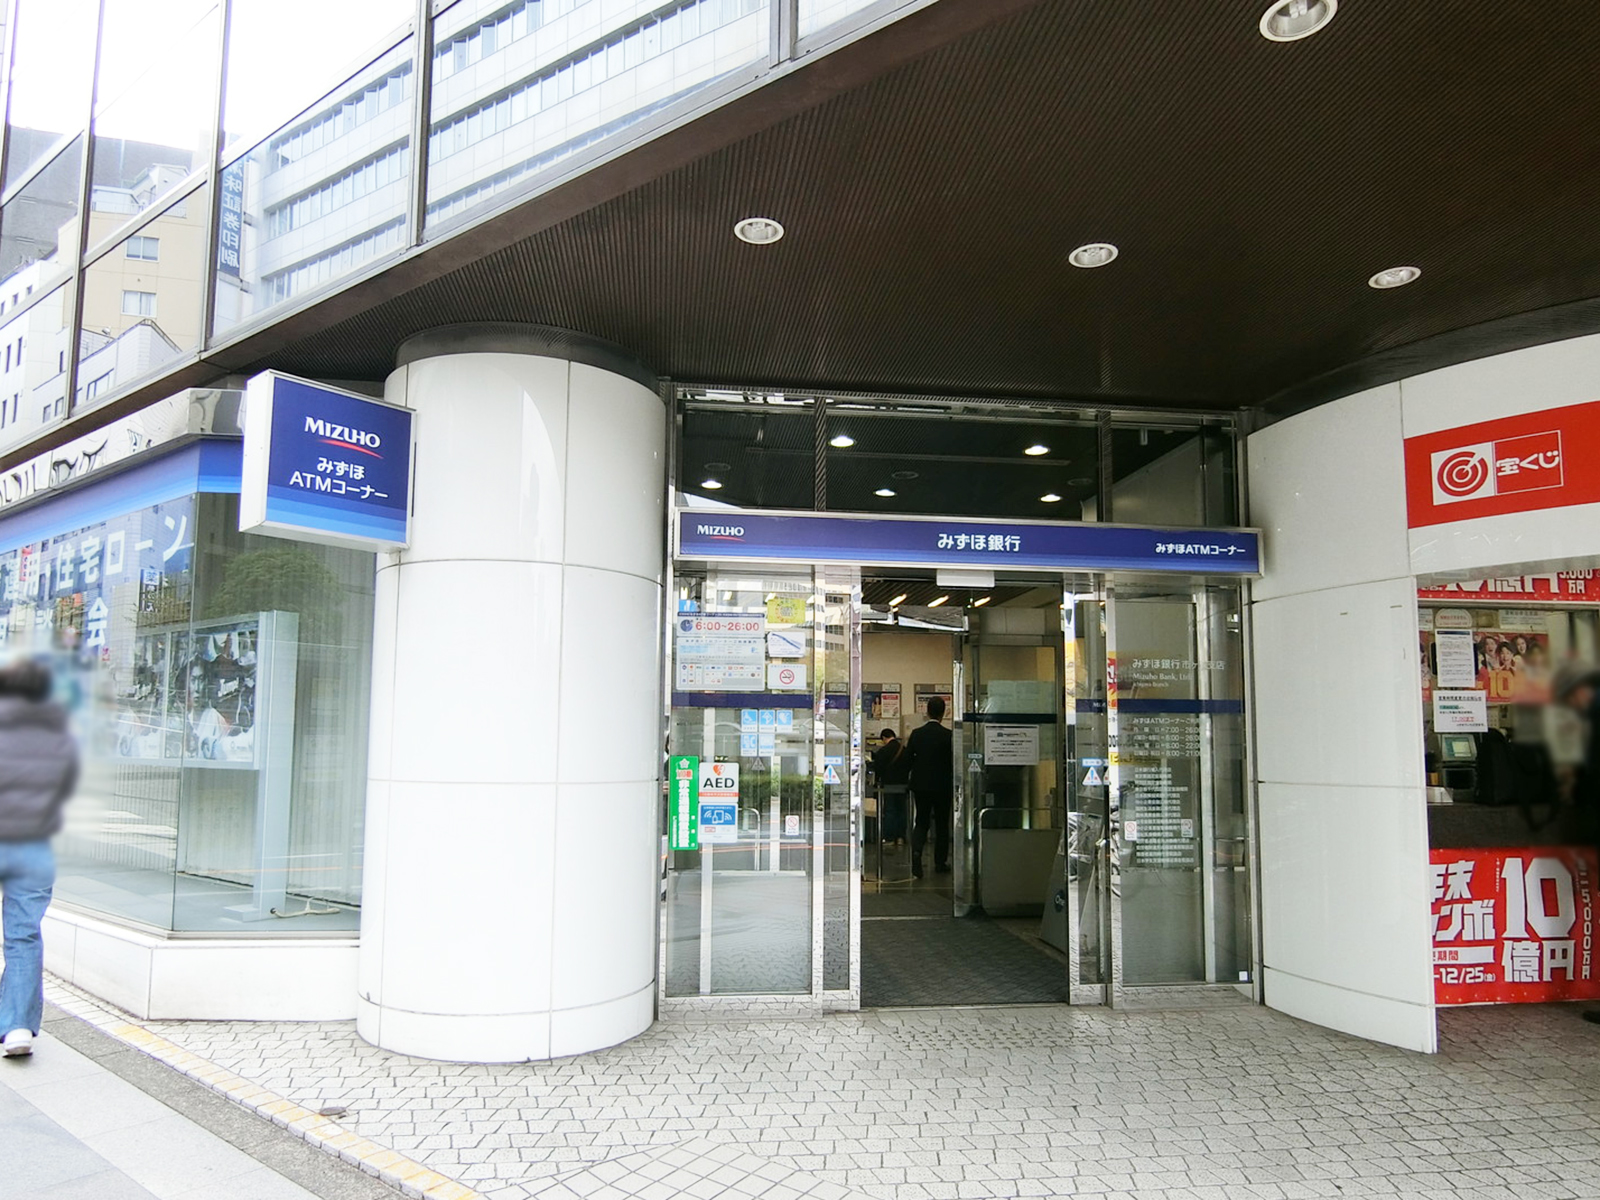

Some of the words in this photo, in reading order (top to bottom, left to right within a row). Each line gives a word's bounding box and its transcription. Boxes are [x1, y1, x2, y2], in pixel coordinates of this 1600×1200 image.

[304, 416, 381, 448] MIZUHO
[317, 457, 365, 480] みずほ
[1496, 450, 1560, 476] 宝くじ
[289, 470, 389, 499] ATMコーナー
[697, 525, 745, 537] MIZUHO
[938, 533, 1021, 552] みずほ銀行
[1155, 542, 1246, 556] みずほATMコーナー
[695, 621, 760, 632] 6:00~26:00
[1159, 673, 1178, 681] Bank,
[703, 777, 735, 788] AED
[1501, 857, 1576, 938] 10
[1501, 940, 1576, 982] 億円
